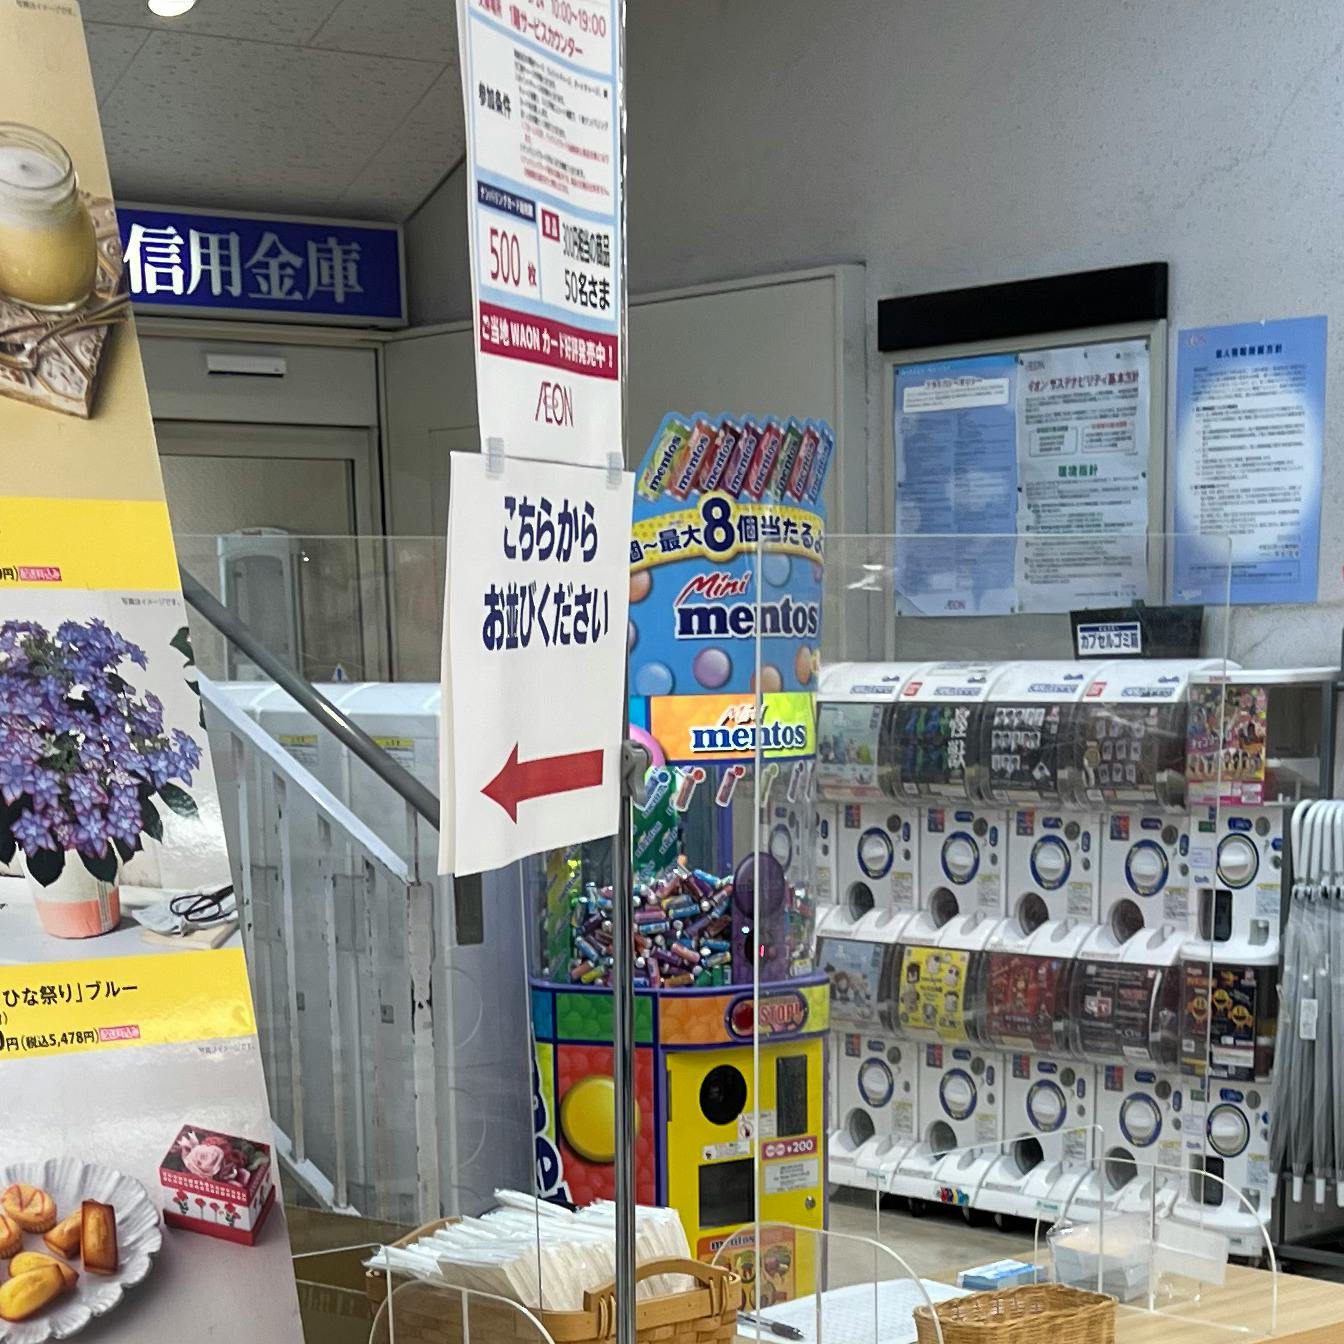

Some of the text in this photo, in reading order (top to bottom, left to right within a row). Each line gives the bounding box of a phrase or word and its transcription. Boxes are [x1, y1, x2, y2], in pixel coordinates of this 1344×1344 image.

[124, 224, 364, 303] 信用金庫
[489, 226, 521, 287] 500
[565, 268, 610, 310] 50名さま
[511, 322, 540, 351] WAON
[649, 434, 682, 491] mentos
[678, 435, 709, 491] mentos
[706, 435, 735, 491] mentos
[731, 435, 757, 492] mentos
[503, 496, 598, 562] こちらから
[482, 581, 608, 651] お並びください
[675, 571, 751, 605] Mini
[675, 596, 818, 637] mentos
[691, 723, 807, 751] mentos
